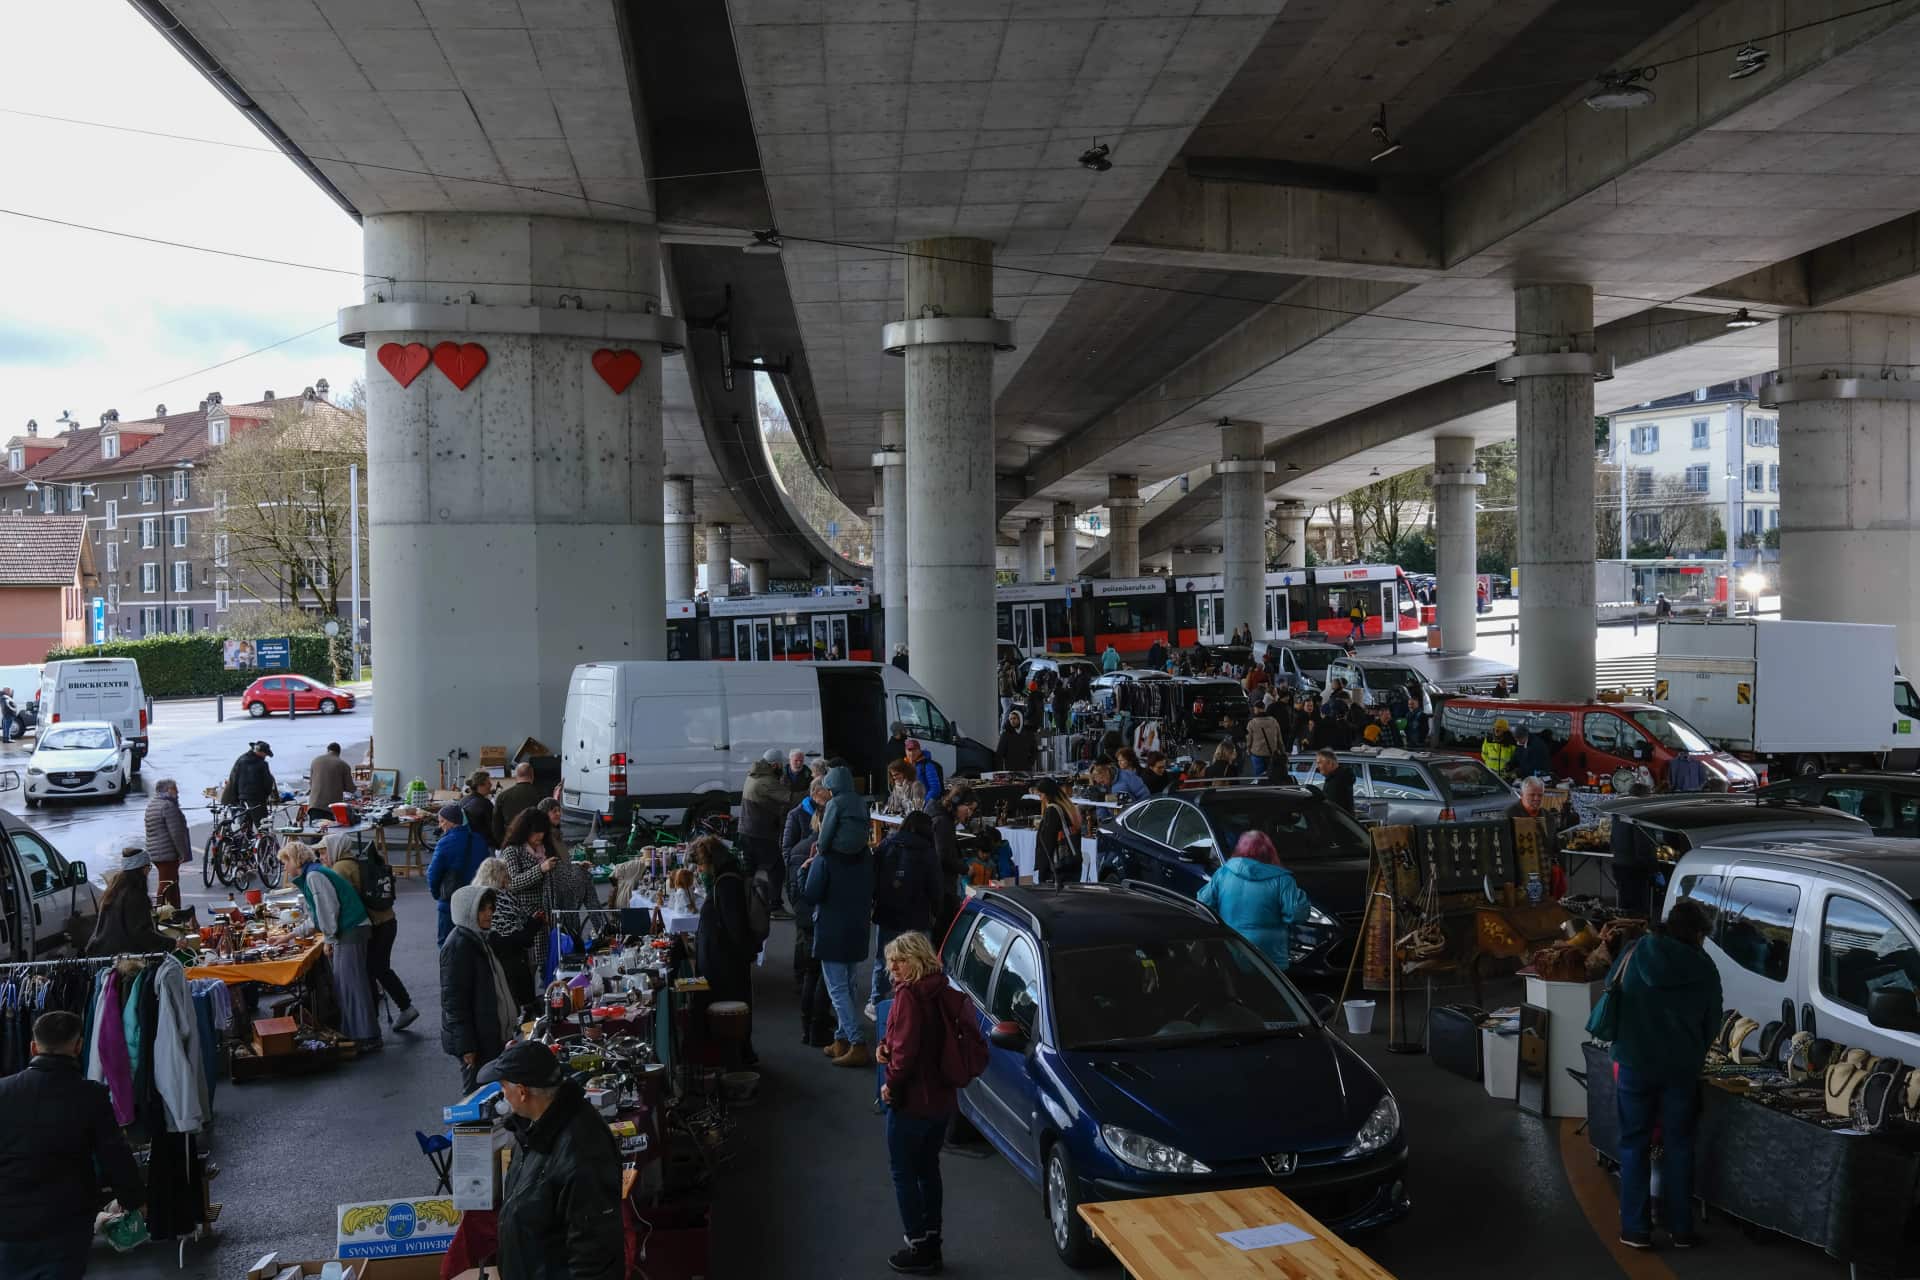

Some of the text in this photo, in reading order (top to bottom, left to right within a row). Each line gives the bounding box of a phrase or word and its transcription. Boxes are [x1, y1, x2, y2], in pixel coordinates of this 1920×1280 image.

[1102, 583, 1156, 593] polizeiberufe.ch
[68, 680, 129, 689] BROCKICENTER
[389, 1213, 412, 1224] Chiquita
[348, 1239, 452, 1257] PREMIUM BANANAS
